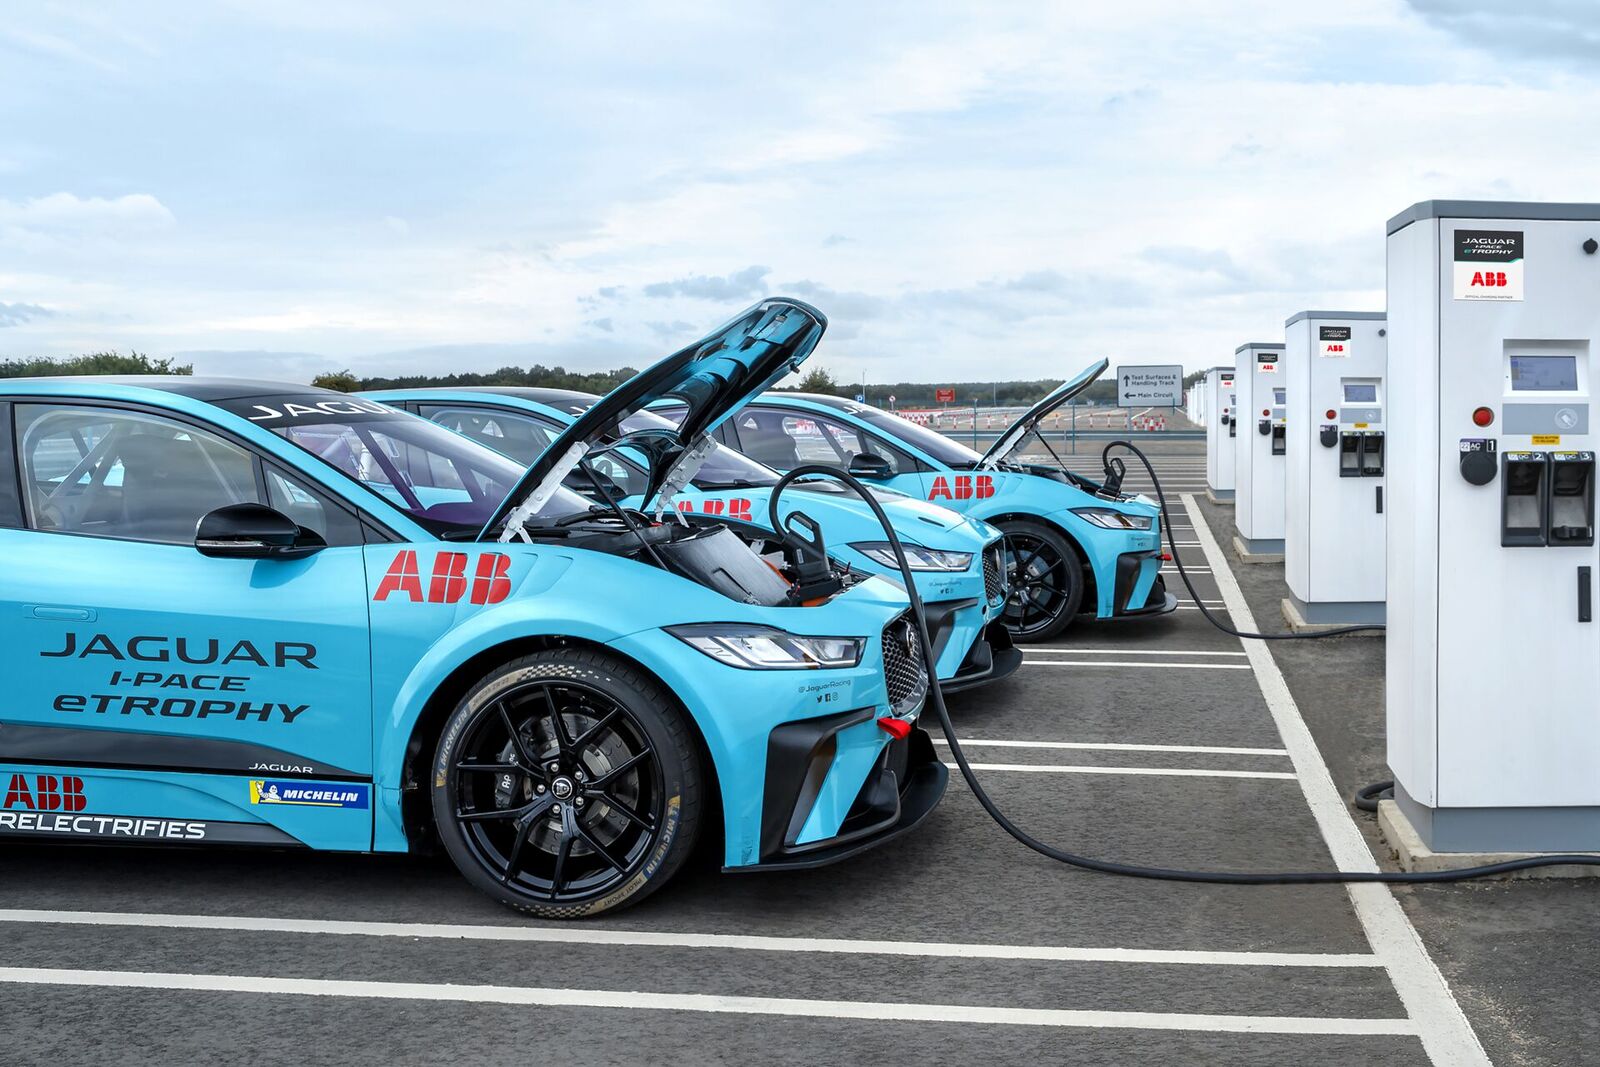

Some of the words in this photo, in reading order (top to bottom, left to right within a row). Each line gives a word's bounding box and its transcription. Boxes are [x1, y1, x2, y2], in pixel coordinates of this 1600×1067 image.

[1471, 272, 1507, 287] ABB
[928, 476, 995, 500] ABB
[373, 550, 512, 605] ABB
[40, 632, 320, 669] JAGUAR
[109, 671, 250, 692] I-PACE
[798, 680, 851, 693] @JaguarRacing
[52, 694, 311, 724] eTROPHY
[440, 709, 468, 766] MICHELIN
[248, 762, 313, 775] JAGUAR
[4, 774, 87, 812] ABB
[282, 789, 359, 803] MICHELIN
